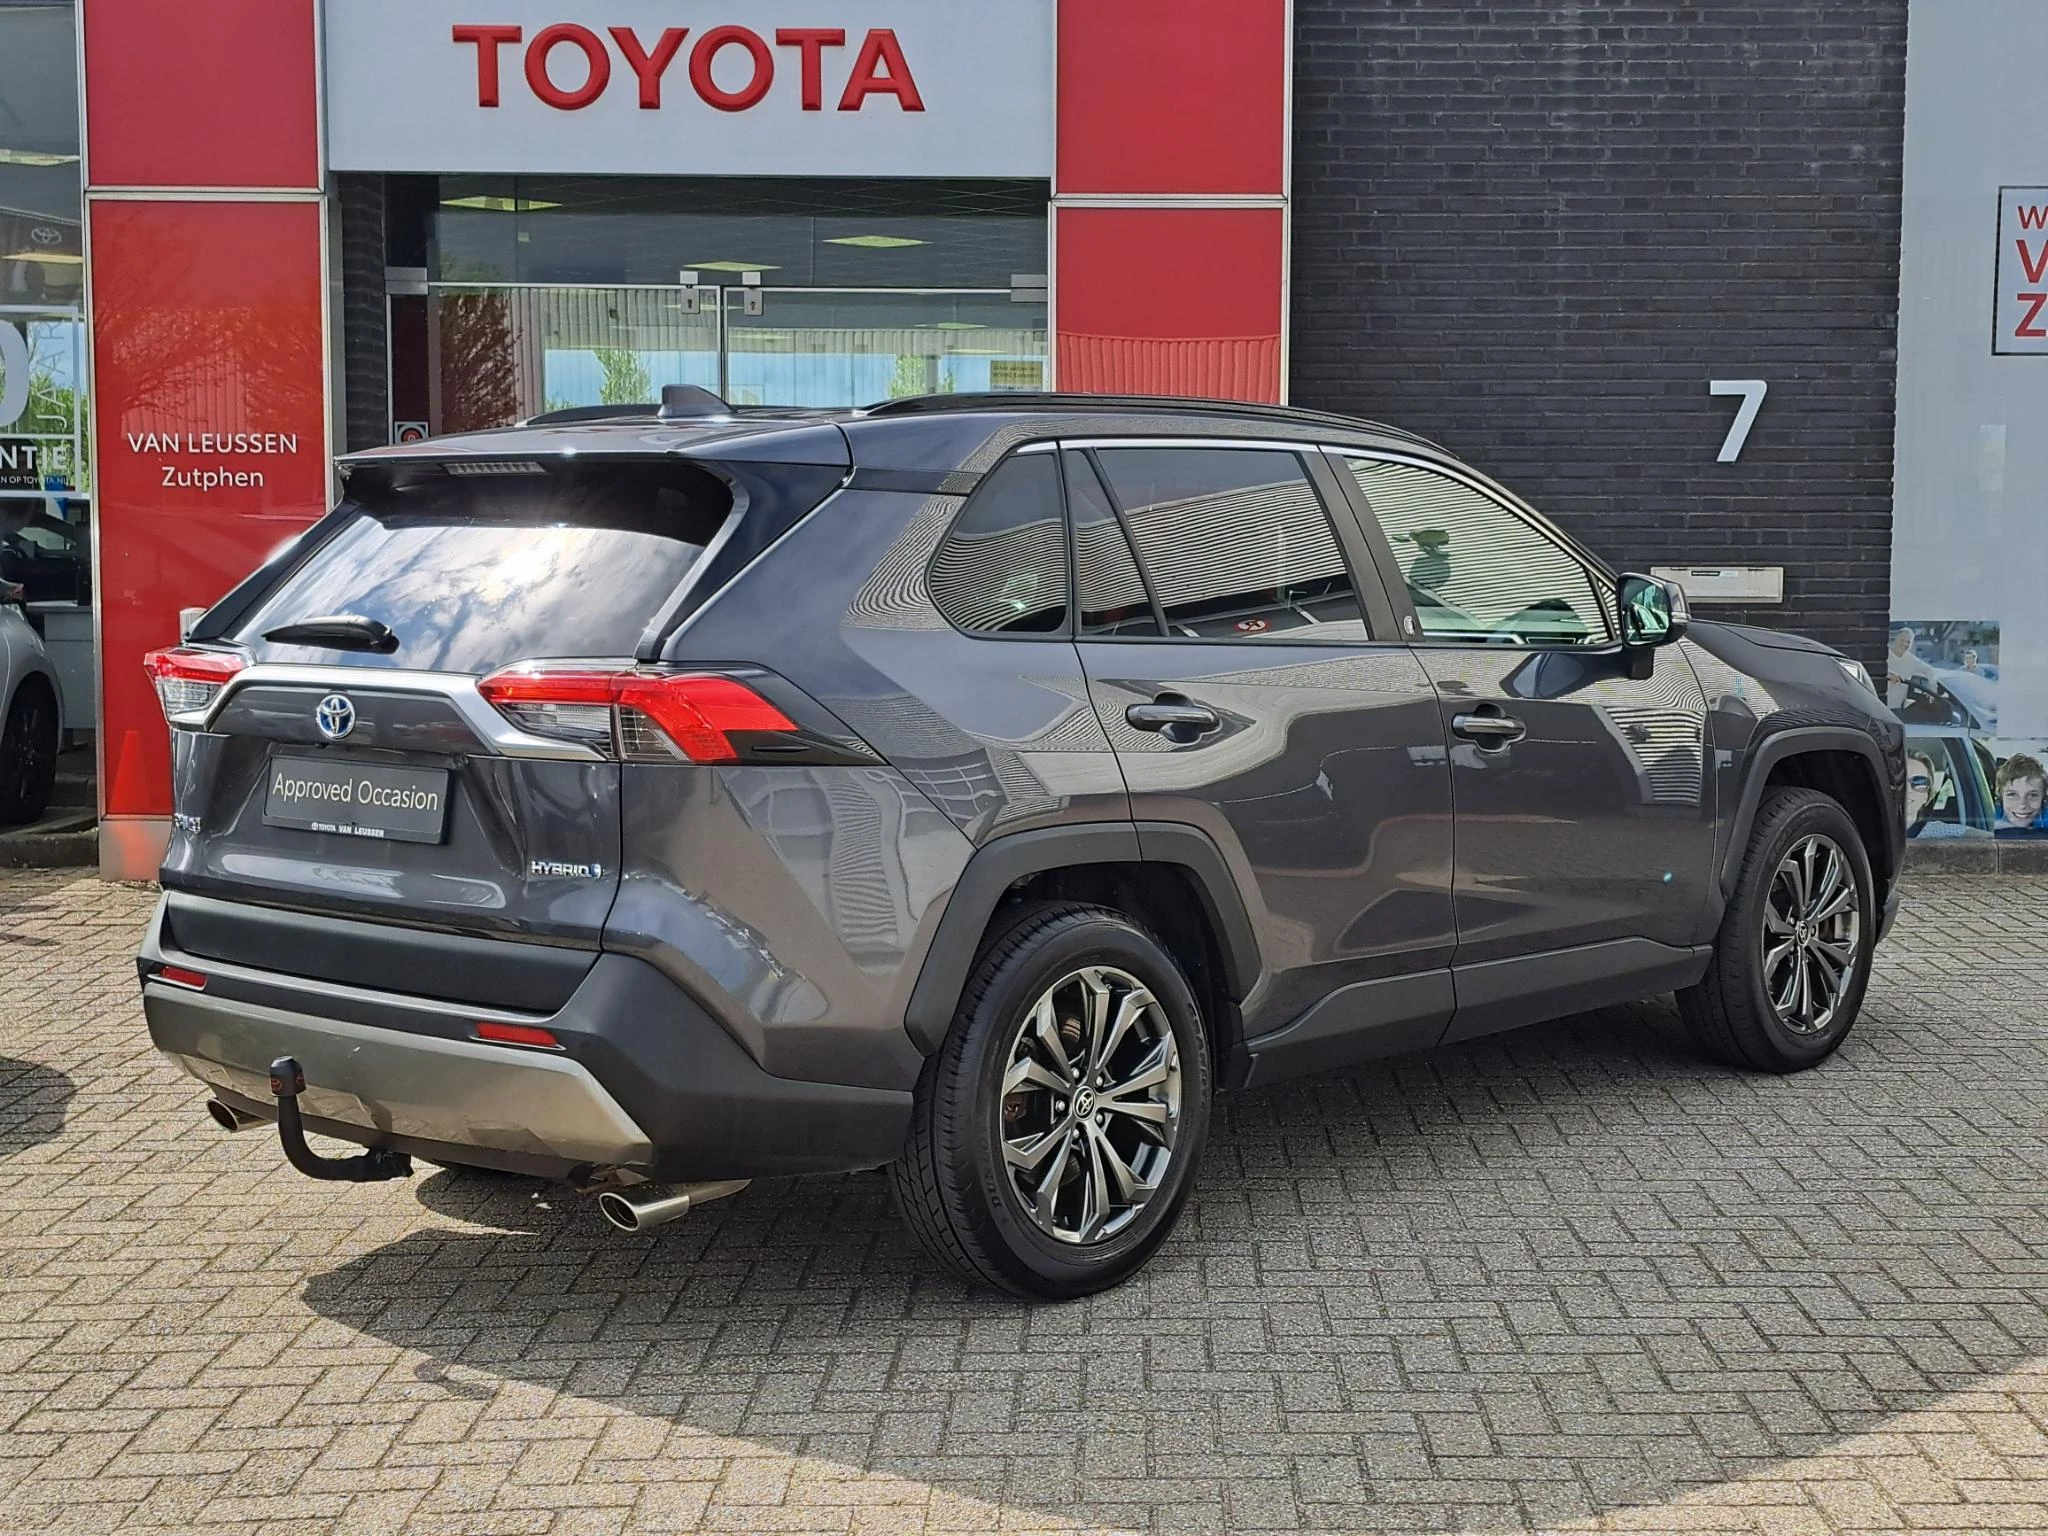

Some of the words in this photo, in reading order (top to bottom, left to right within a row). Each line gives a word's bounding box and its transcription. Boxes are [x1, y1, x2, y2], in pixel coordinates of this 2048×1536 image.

[452, 23, 926, 112] TOYOTA
[1709, 379, 1768, 463] 7
[127, 432, 180, 454] VAN
[187, 432, 298, 455] LEUSSEN
[161, 465, 265, 492] Zutphen
[272, 772, 353, 804] Approved
[358, 780, 439, 812] Occasion
[318, 823, 337, 833] TOYOTA
[338, 824, 352, 836] VAN
[353, 826, 385, 839] LEUSSEN
[531, 860, 592, 879] HYBRID
